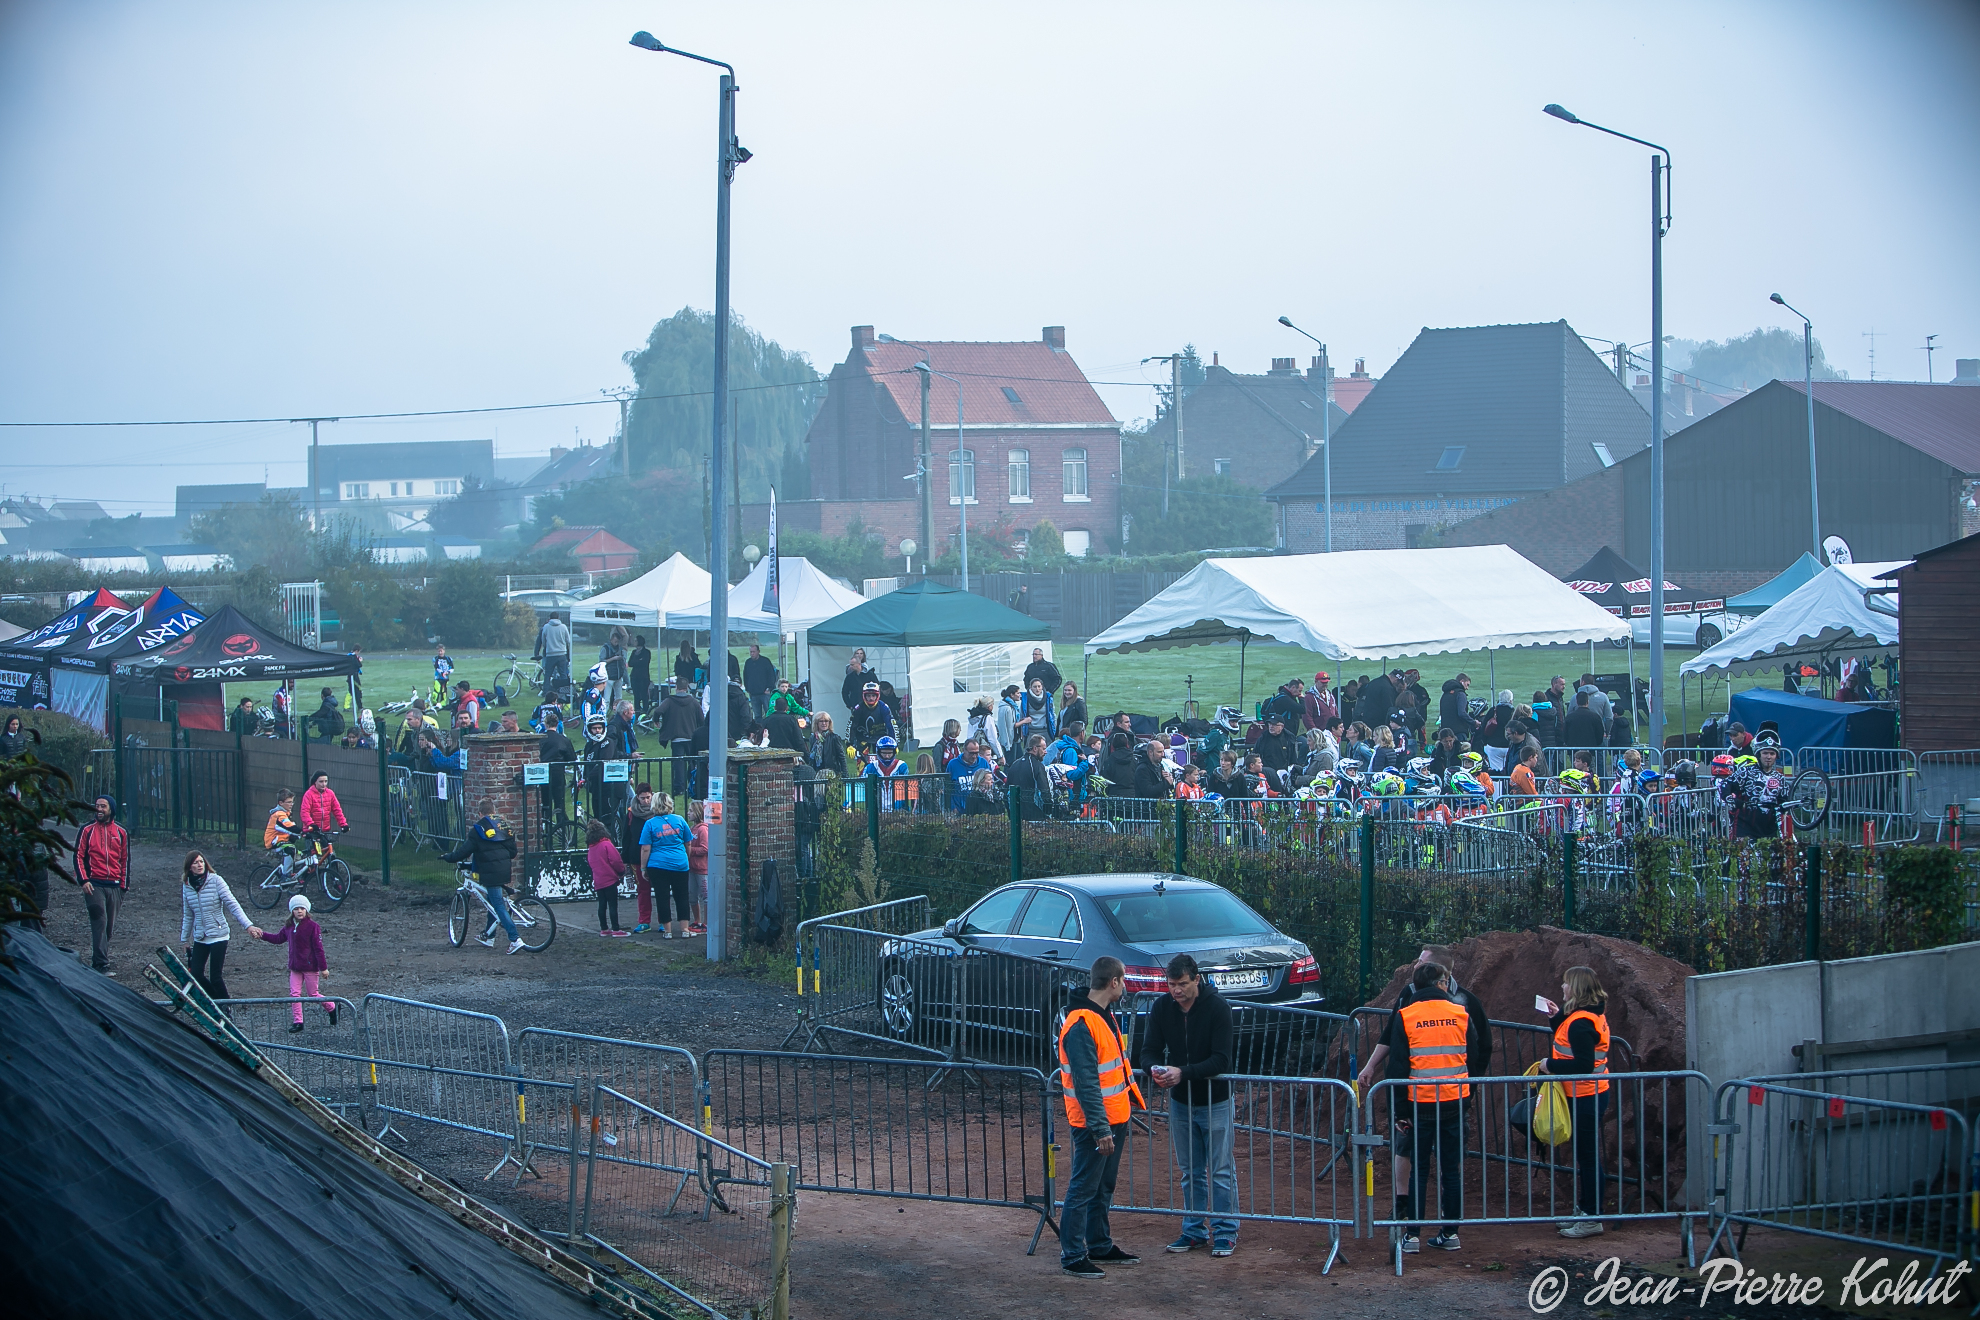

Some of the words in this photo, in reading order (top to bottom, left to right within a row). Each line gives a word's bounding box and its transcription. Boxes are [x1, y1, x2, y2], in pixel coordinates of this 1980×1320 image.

[1316, 502, 1346, 512] BSE
[1623, 579, 1680, 592] KEA
[192, 666, 248, 679] 24MX
[1416, 1018, 1458, 1029] ARBITRE
